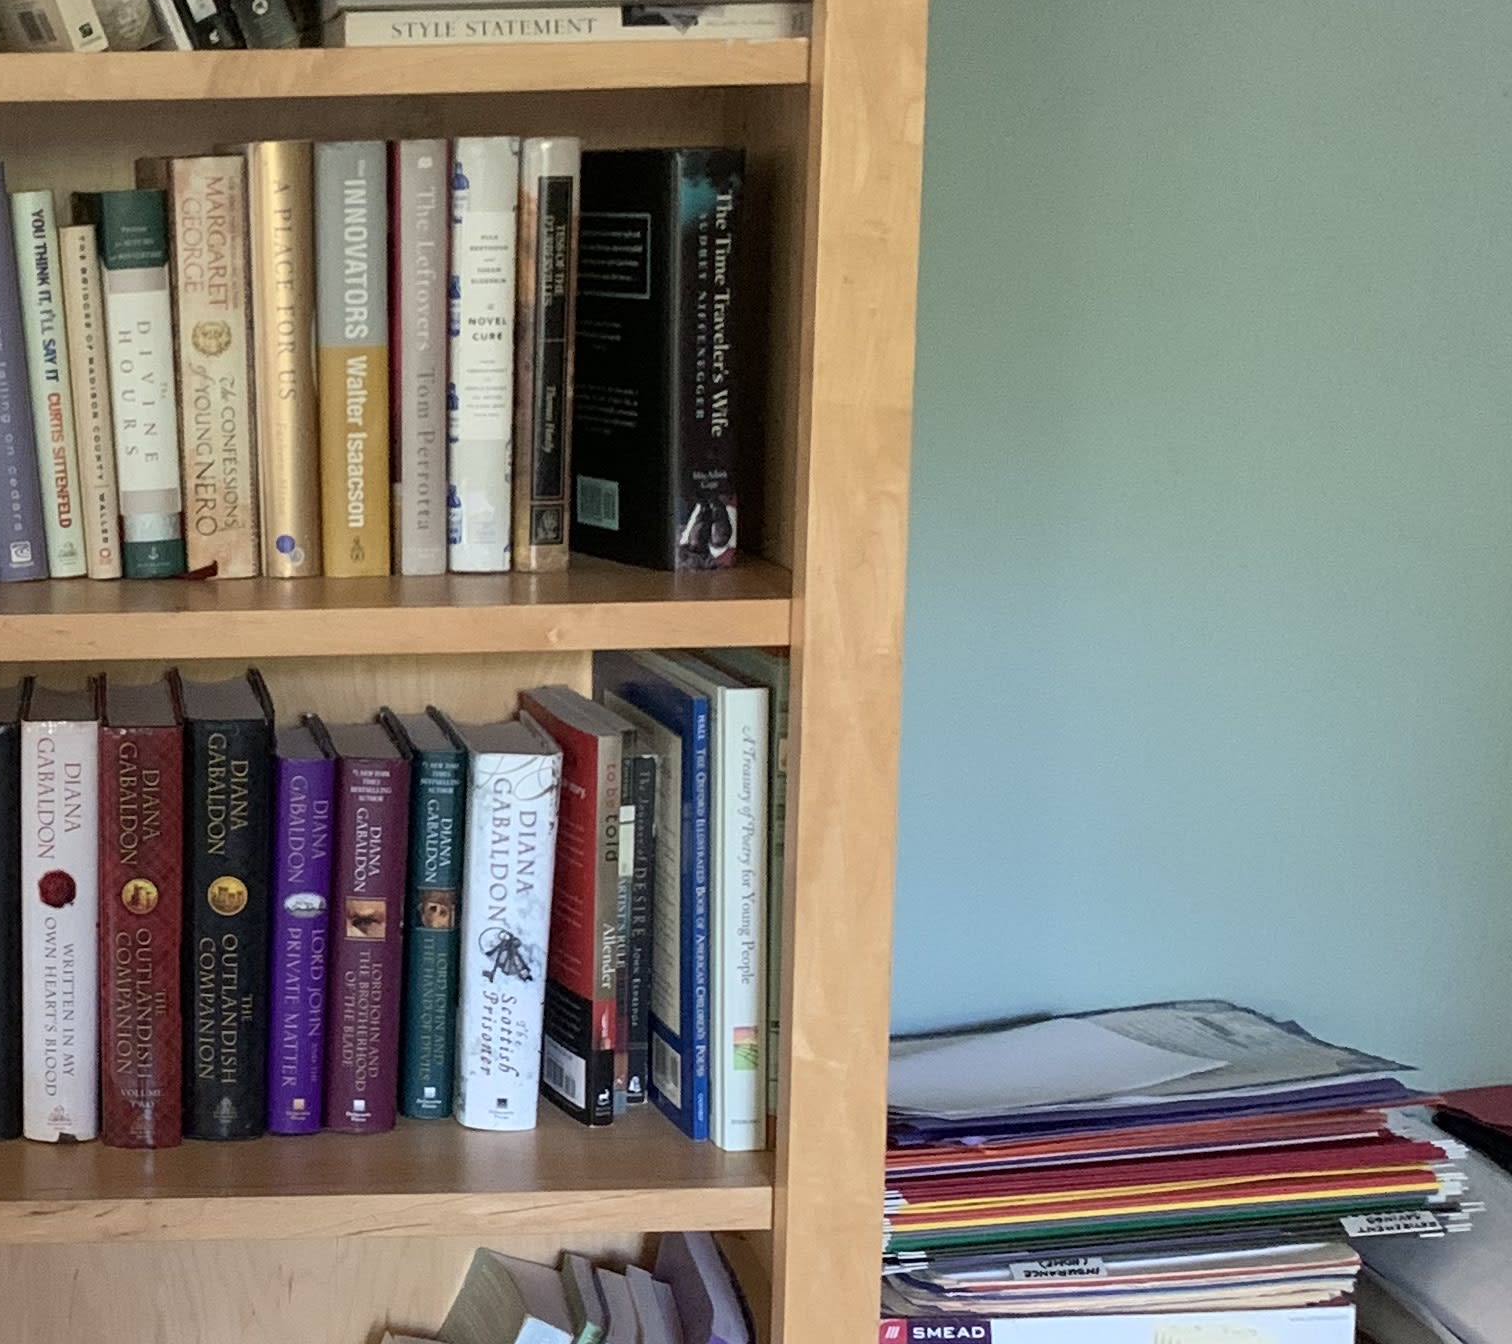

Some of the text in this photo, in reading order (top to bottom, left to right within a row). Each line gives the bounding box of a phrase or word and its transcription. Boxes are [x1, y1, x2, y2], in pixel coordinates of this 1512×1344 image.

[391, 18, 597, 38] STYLE STATEMENT
[31, 208, 46, 240] YOU
[33, 243, 50, 287] THINK
[344, 179, 369, 339] INNOVATORS
[42, 338, 57, 367] SAY
[710, 191, 732, 438] The Time Traveler's Wife
[45, 368, 59, 382] IT
[48, 393, 73, 529] CURTIS SITTENFELD
[347, 355, 367, 528] Walter Isaacson
[37, 737, 55, 859] GABALDON
[63, 762, 81, 833] DIANA
[119, 742, 137, 865] GABALDON
[142, 769, 160, 840] DIANA
[207, 733, 226, 855] GABALDON
[231, 760, 248, 830] DIANA
[604, 815, 619, 862] told
[198, 937, 215, 1079] COMPANION
[222, 934, 238, 1083] OUTLANDISH
[480, 990, 496, 1076] Prisoner
[499, 993, 519, 1076] Scottish
[912, 1326, 986, 1339] SMEAD
